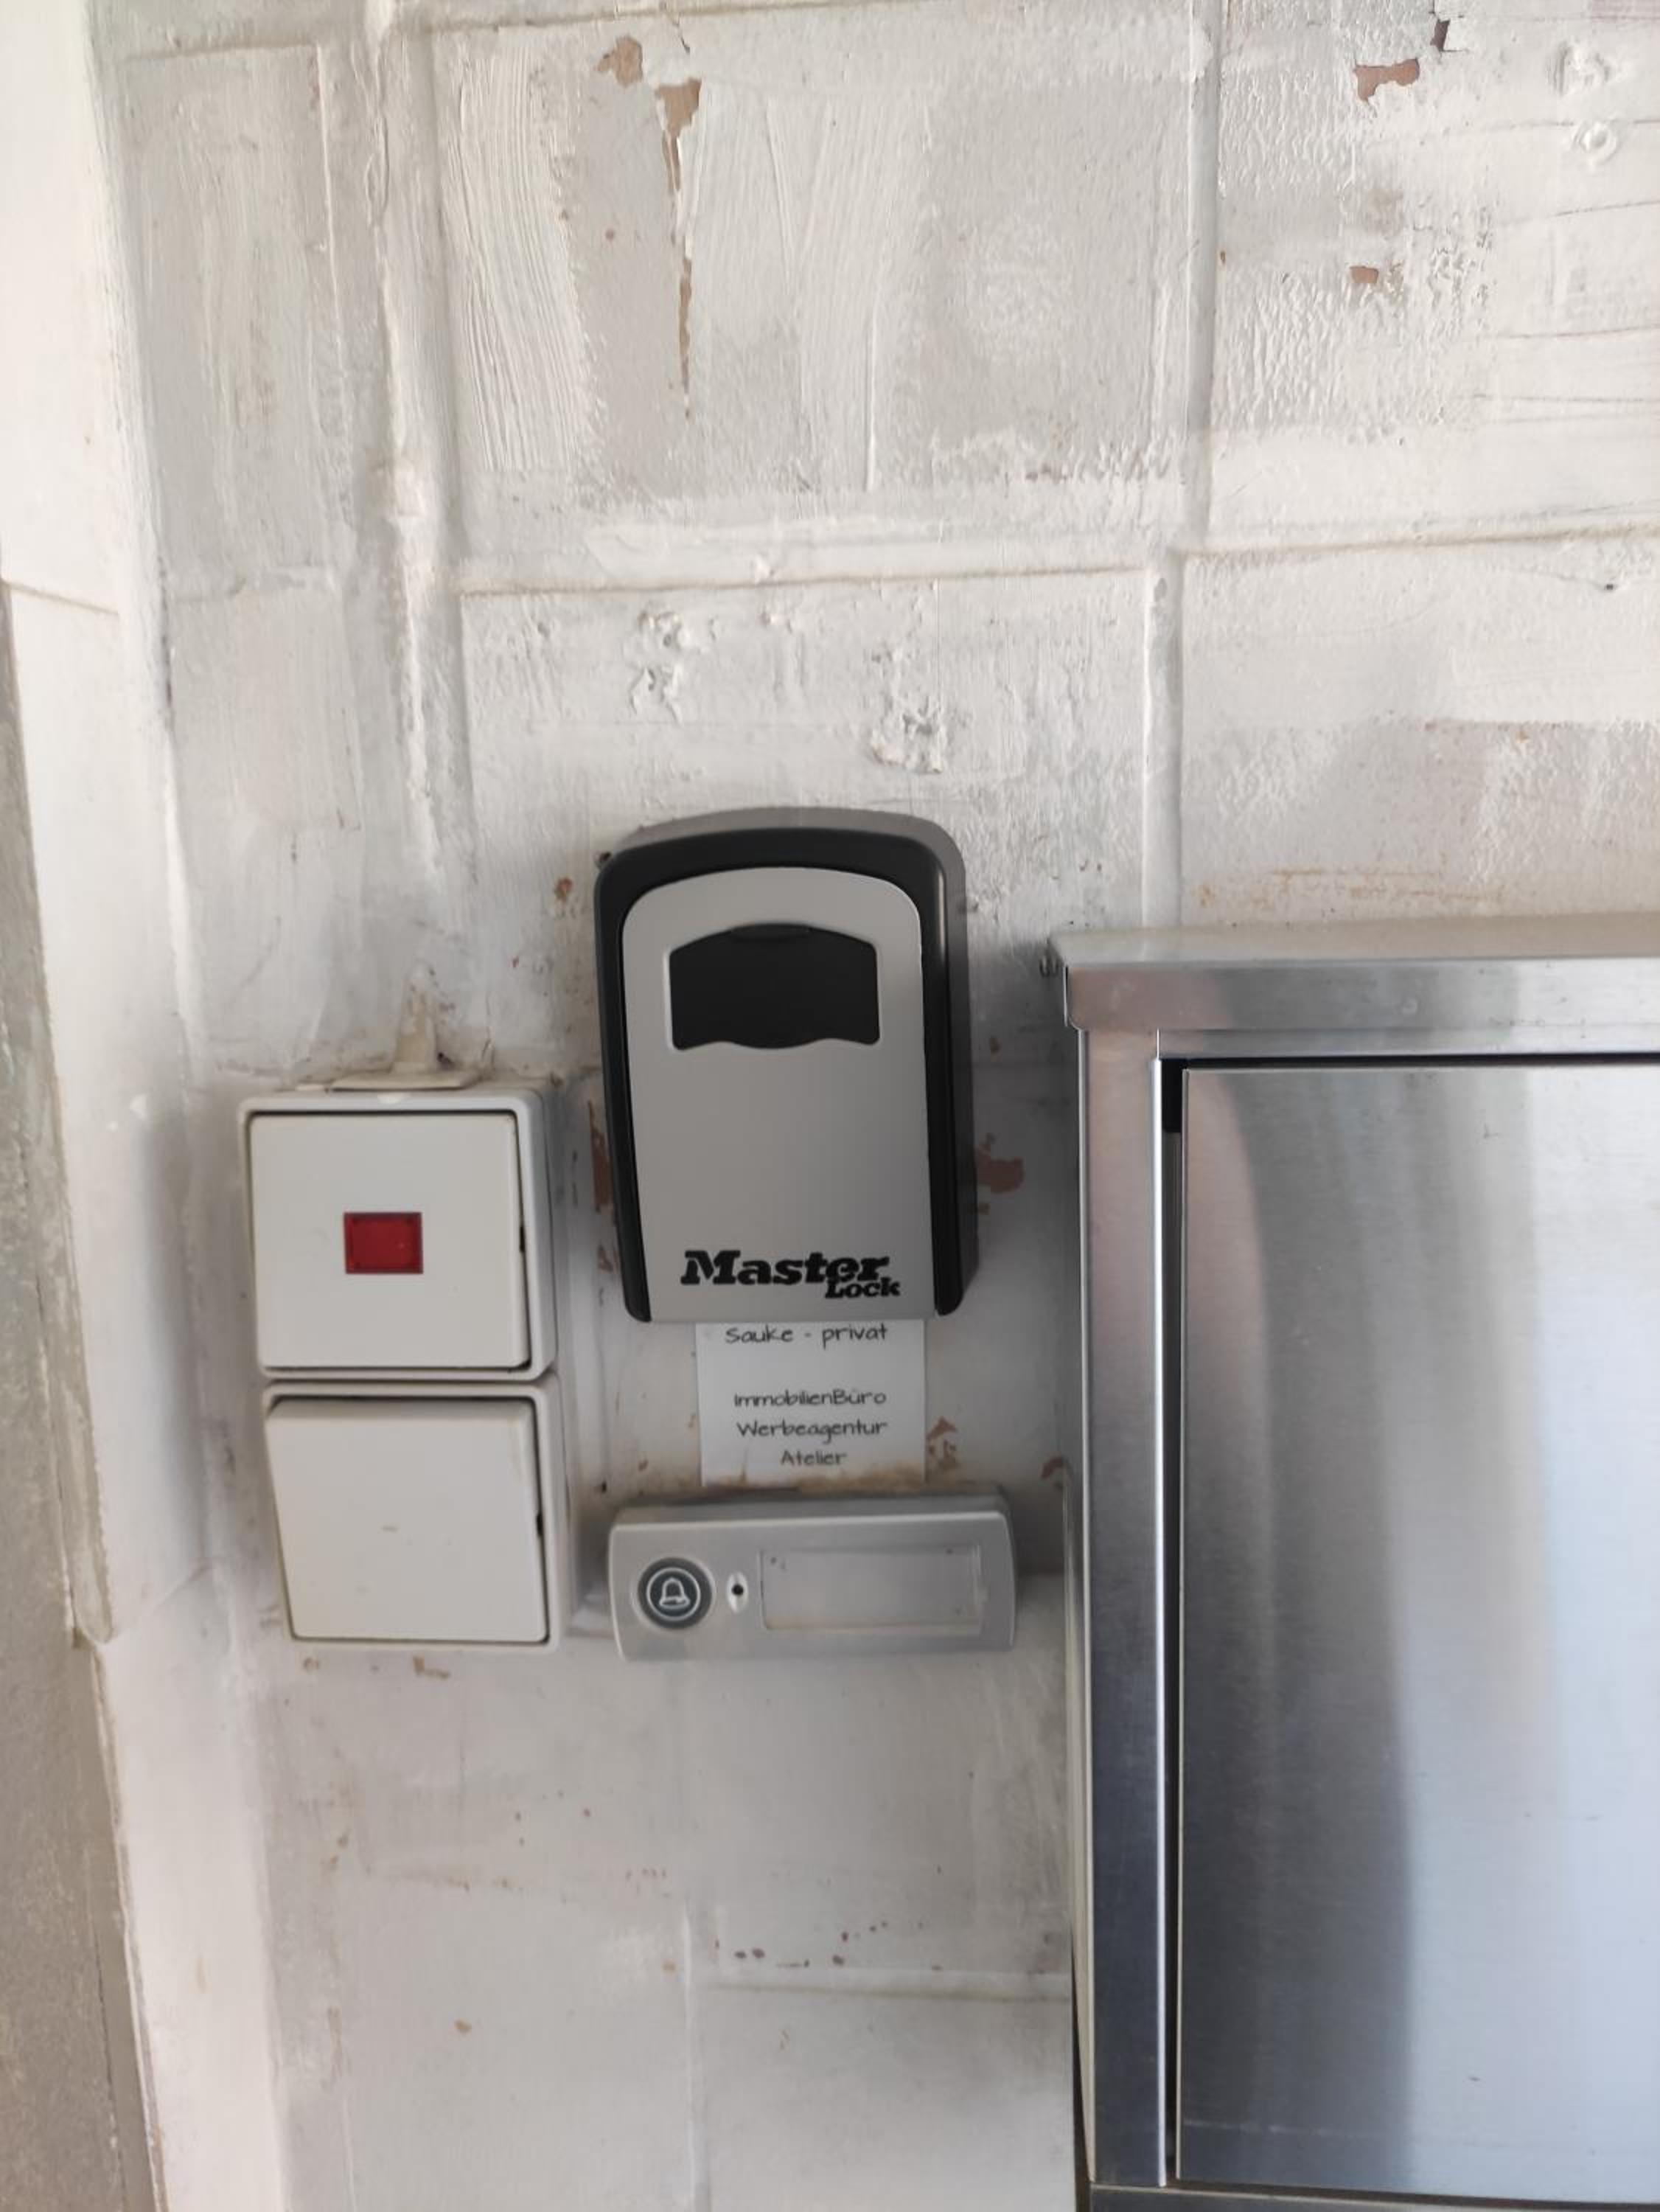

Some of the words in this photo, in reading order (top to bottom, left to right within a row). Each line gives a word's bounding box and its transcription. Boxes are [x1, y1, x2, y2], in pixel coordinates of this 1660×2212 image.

[680, 1250, 890, 1285] Master
[824, 1277, 901, 1299] Lock
[725, 1325, 794, 1344] Sauke
[822, 1324, 887, 1350] privat
[734, 1388, 887, 1407] ImmobilienBüro
[736, 1419, 887, 1444] Werbeagentur
[780, 1450, 847, 1467] Atelier
